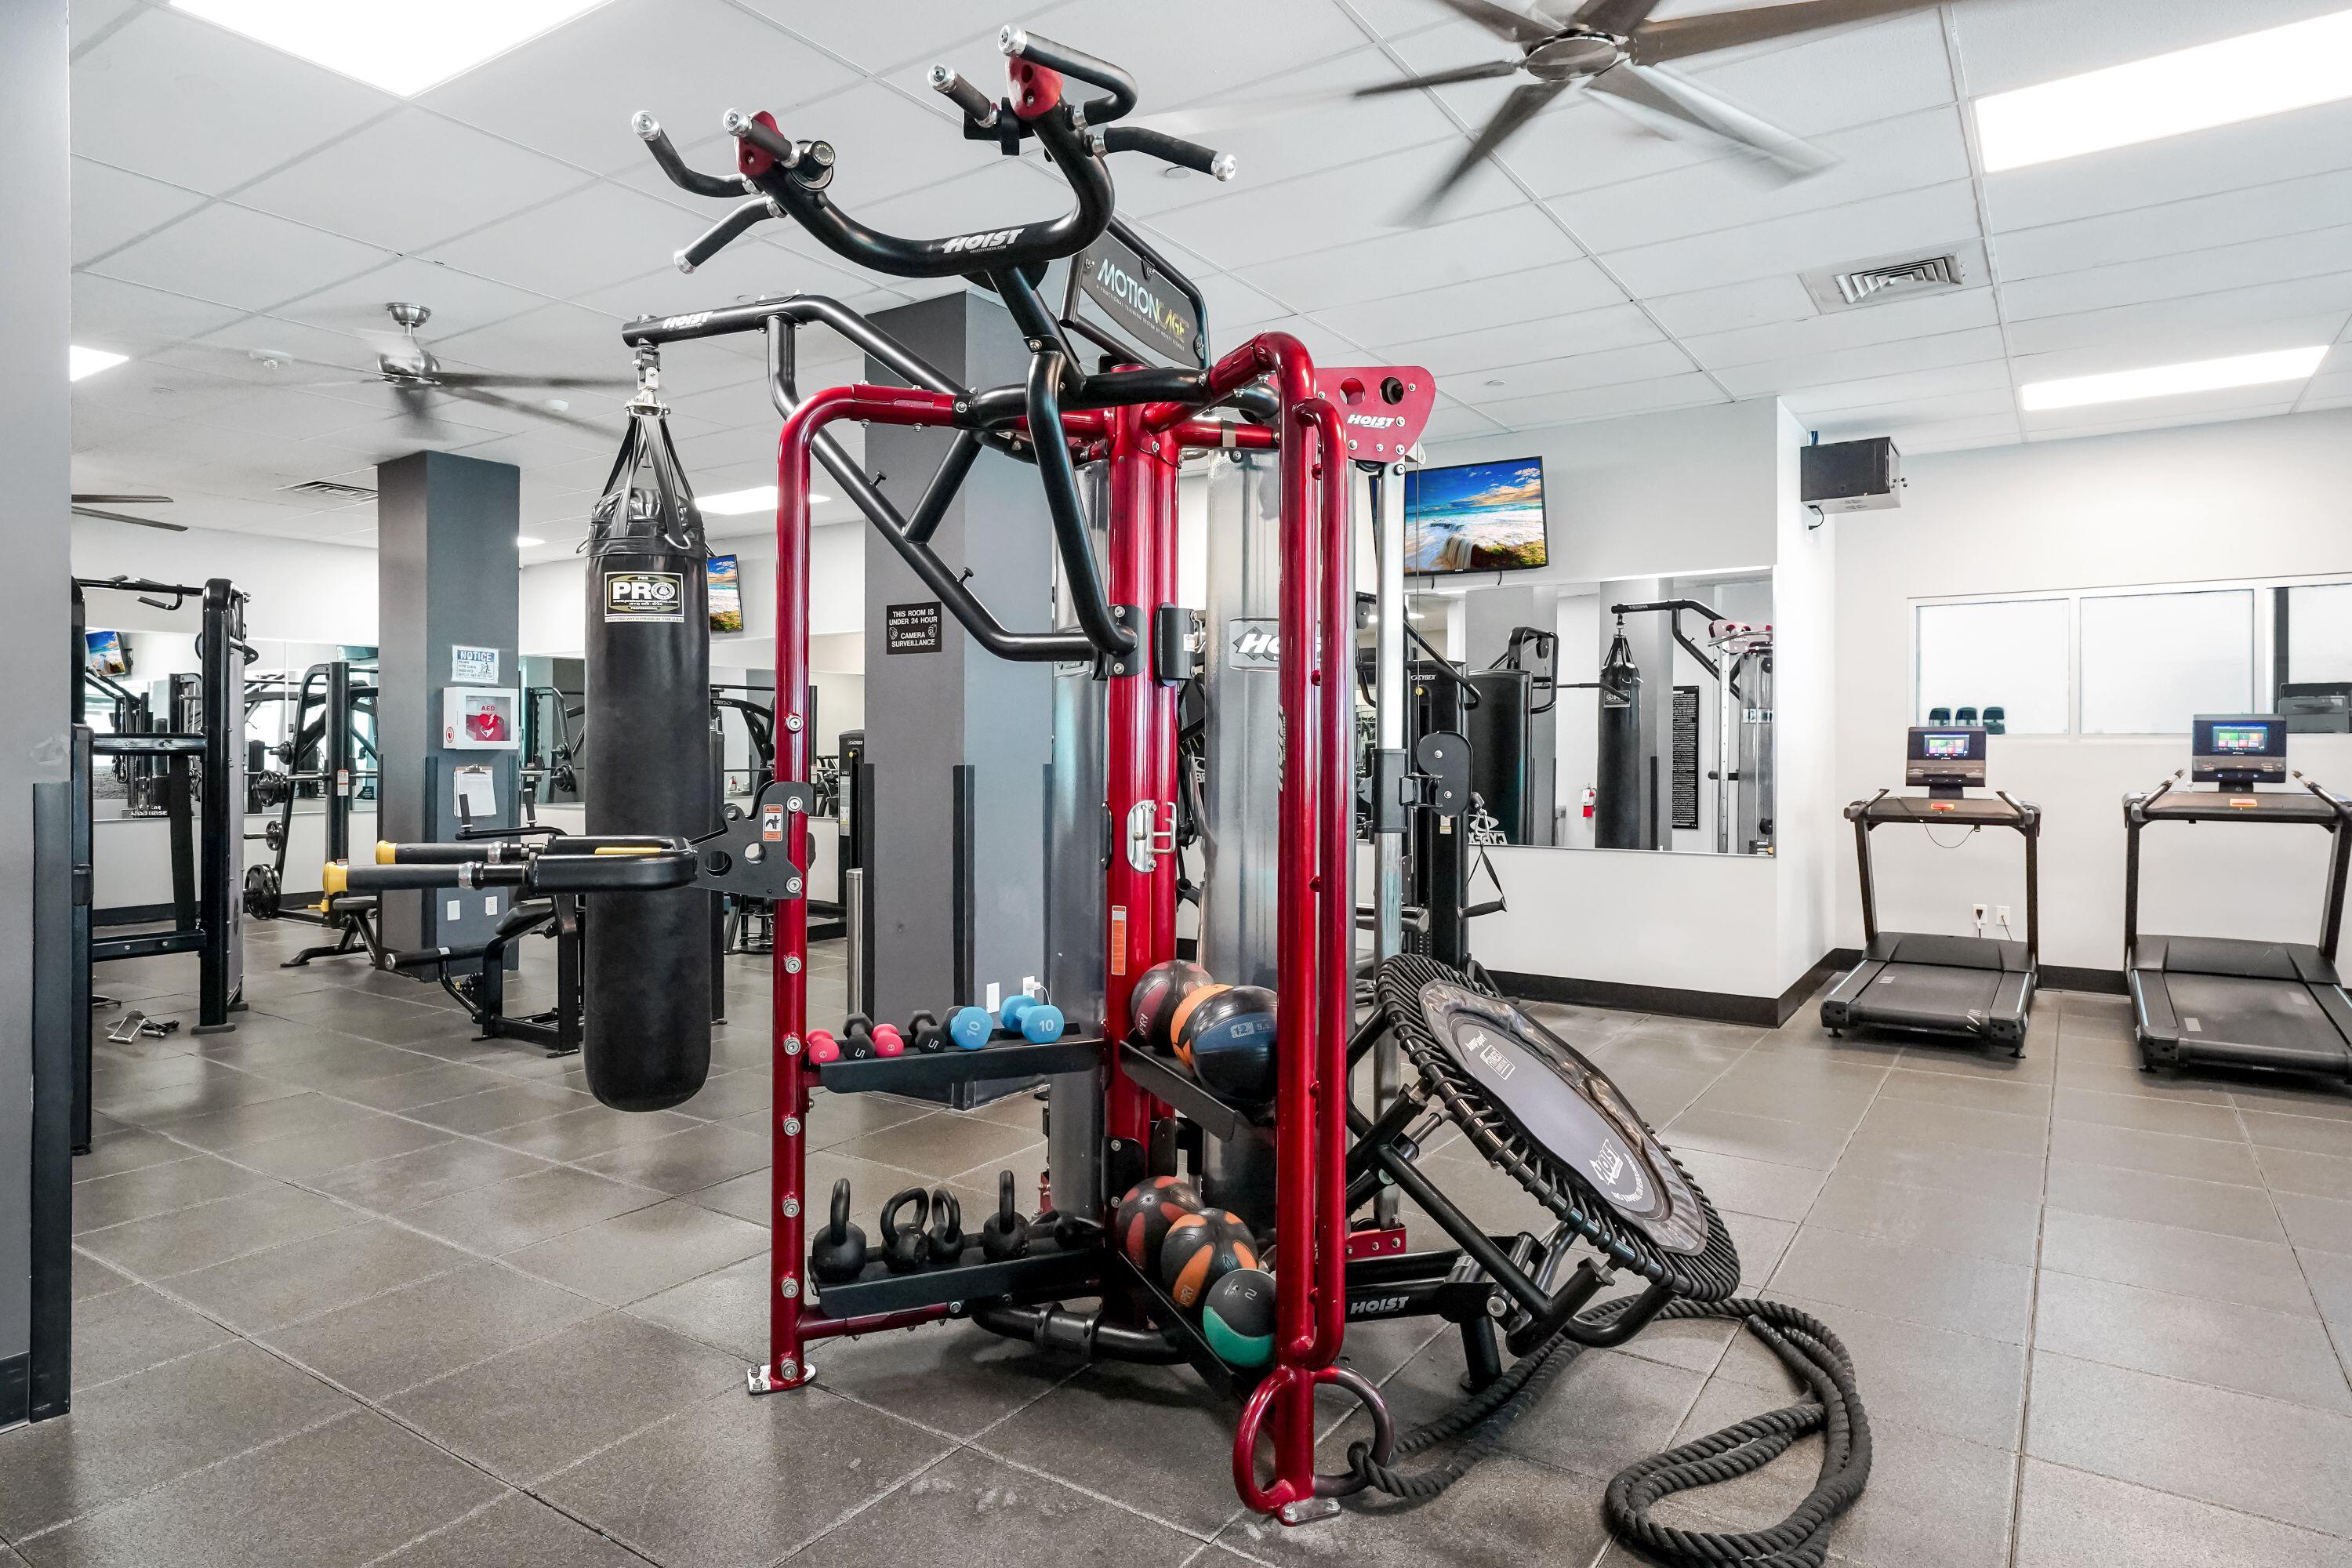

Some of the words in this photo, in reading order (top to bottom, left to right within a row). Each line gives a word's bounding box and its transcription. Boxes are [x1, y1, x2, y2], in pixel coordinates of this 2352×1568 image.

[942, 228, 1025, 253] HOIST
[662, 311, 713, 329] HOIST
[1347, 414, 1395, 427] HOIST
[612, 582, 676, 600] PRO
[891, 639, 935, 648] SURVEILLANCE
[460, 651, 493, 662] NOTICE
[966, 1021, 980, 1036] 10
[1039, 1019, 1054, 1032] 10
[928, 1038, 938, 1050] 5
[855, 1047, 866, 1058] 5
[1589, 1138, 1619, 1185] HOIST
[1350, 1296, 1409, 1314] HOIST
